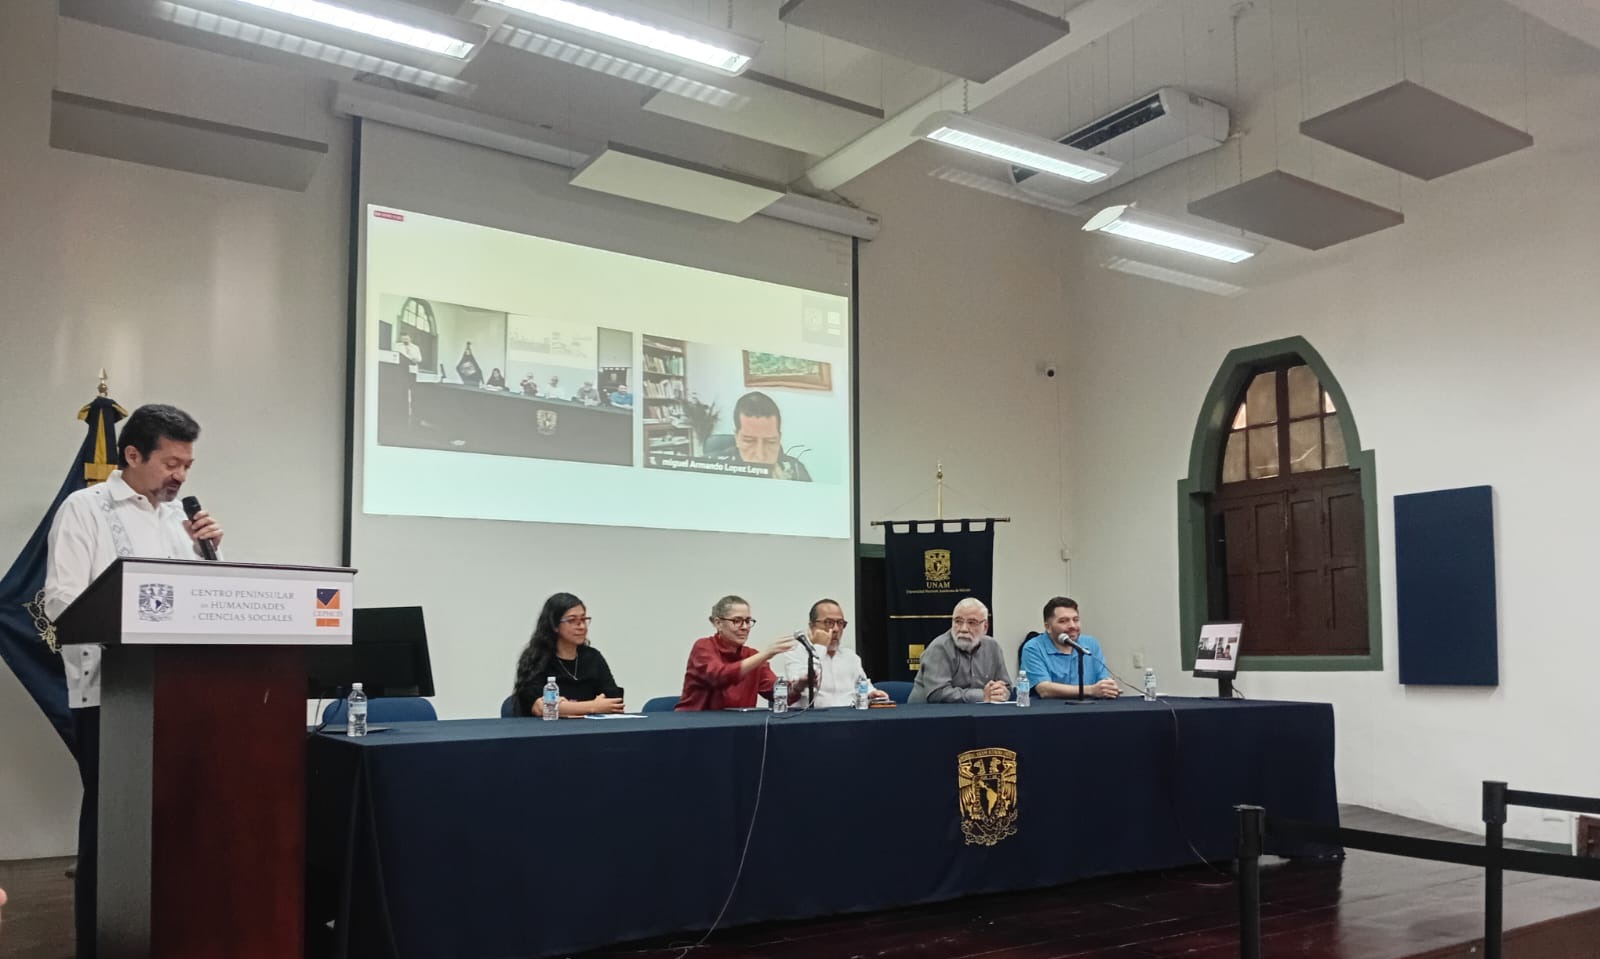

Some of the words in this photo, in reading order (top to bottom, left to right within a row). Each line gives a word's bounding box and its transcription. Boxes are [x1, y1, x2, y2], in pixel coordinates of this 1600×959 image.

[662, 459, 689, 468] miguel
[690, 461, 723, 471] Armando
[926, 581, 951, 589] UNAM
[191, 589, 233, 598] CENTRO
[235, 590, 295, 600] PENINSULAR
[210, 601, 286, 610] HUMANIDADES
[198, 612, 246, 622] CIENCIAS
[247, 613, 293, 622] SOCIALES
